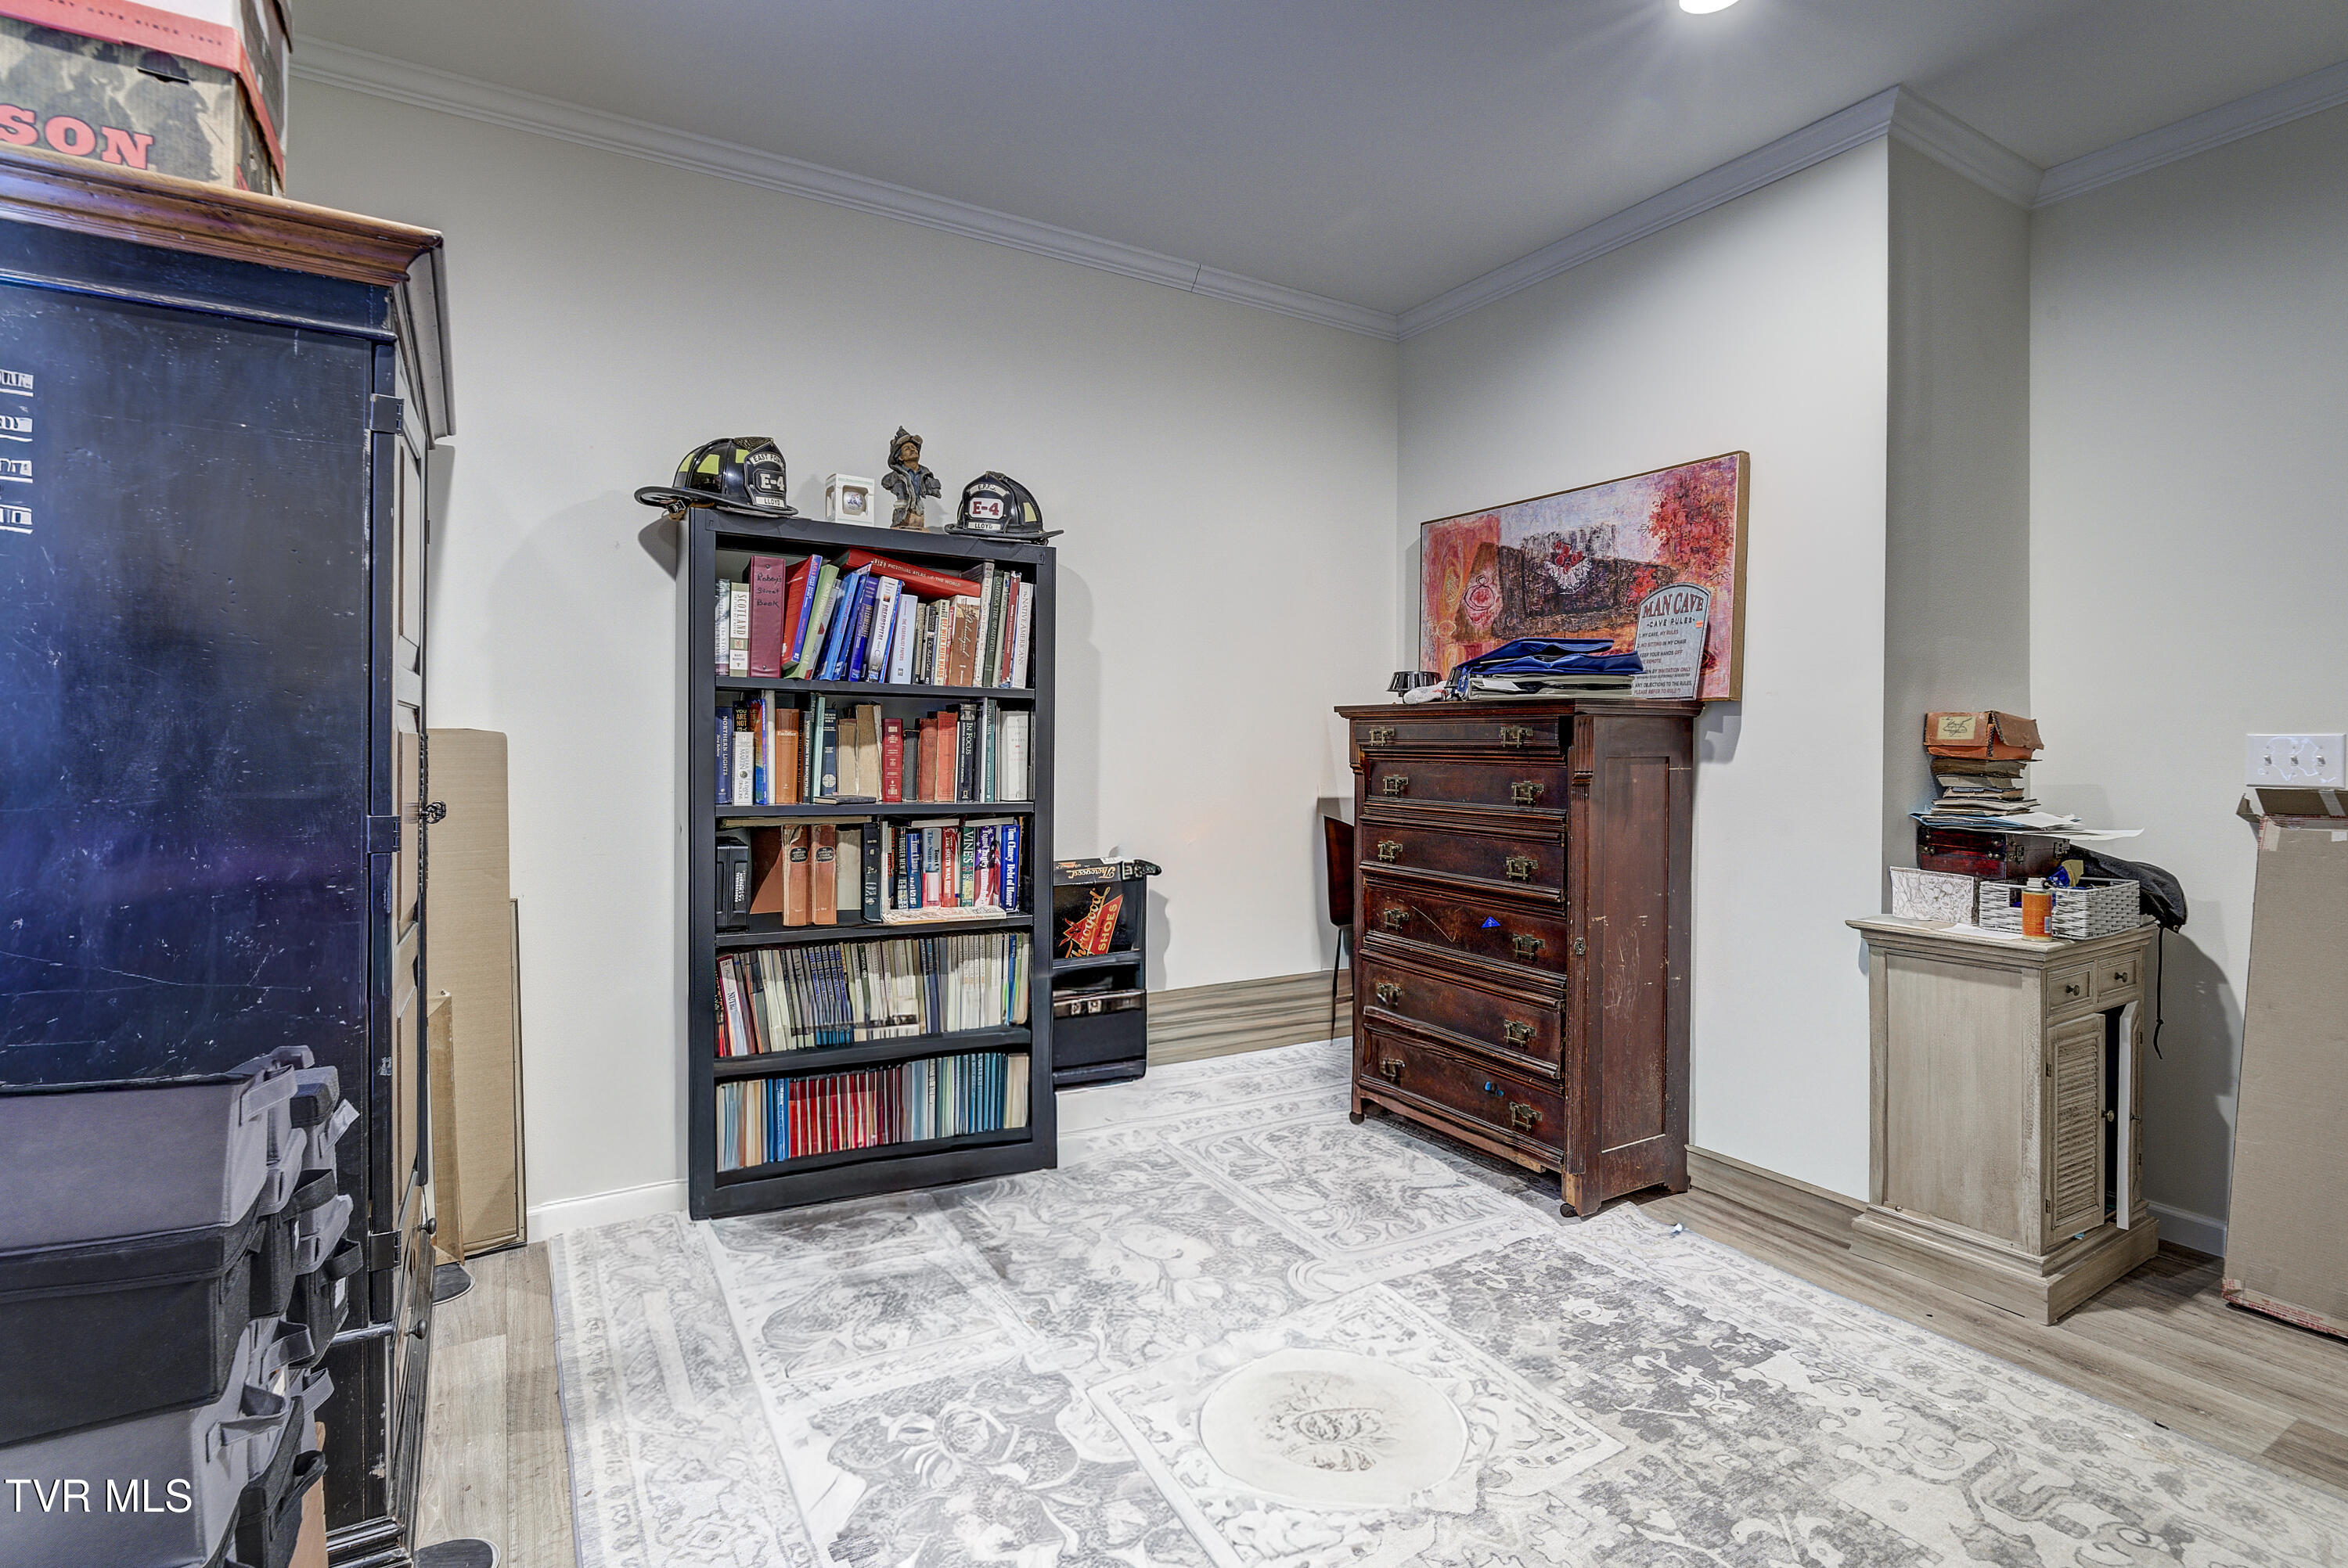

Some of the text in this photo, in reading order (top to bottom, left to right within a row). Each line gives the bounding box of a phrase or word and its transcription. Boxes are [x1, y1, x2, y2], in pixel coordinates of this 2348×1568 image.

[753, 453, 783, 465] EAST POIN
[760, 473, 784, 491] E-4
[764, 497, 780, 506] LLOYD
[972, 501, 999, 516] E-4
[994, 576, 1003, 606] AMERICA
[736, 594, 747, 635] SCOTLAND
[824, 596, 834, 618] BARBARA
[1021, 597, 1029, 623] NATIVE
[1642, 592, 1704, 618] MAN CAVE
[862, 605, 873, 638] INTERMEDIATE
[877, 604, 888, 641] PREHOSPITAL
[989, 620, 999, 653] BEAUTIFUL
[1017, 623, 1028, 665] AMERICANS
[966, 722, 974, 731] IN
[981, 830, 989, 846] Tom
[1007, 827, 1016, 841] Tom
[910, 839, 920, 853] Tom
[1005, 841, 1016, 862] Clancy
[980, 845, 991, 869] Clancy
[1007, 863, 1015, 879] Debt
[1066, 866, 1115, 879] Thorogood
[1006, 886, 1015, 907] Honor
[1097, 904, 1118, 951] SHOES
